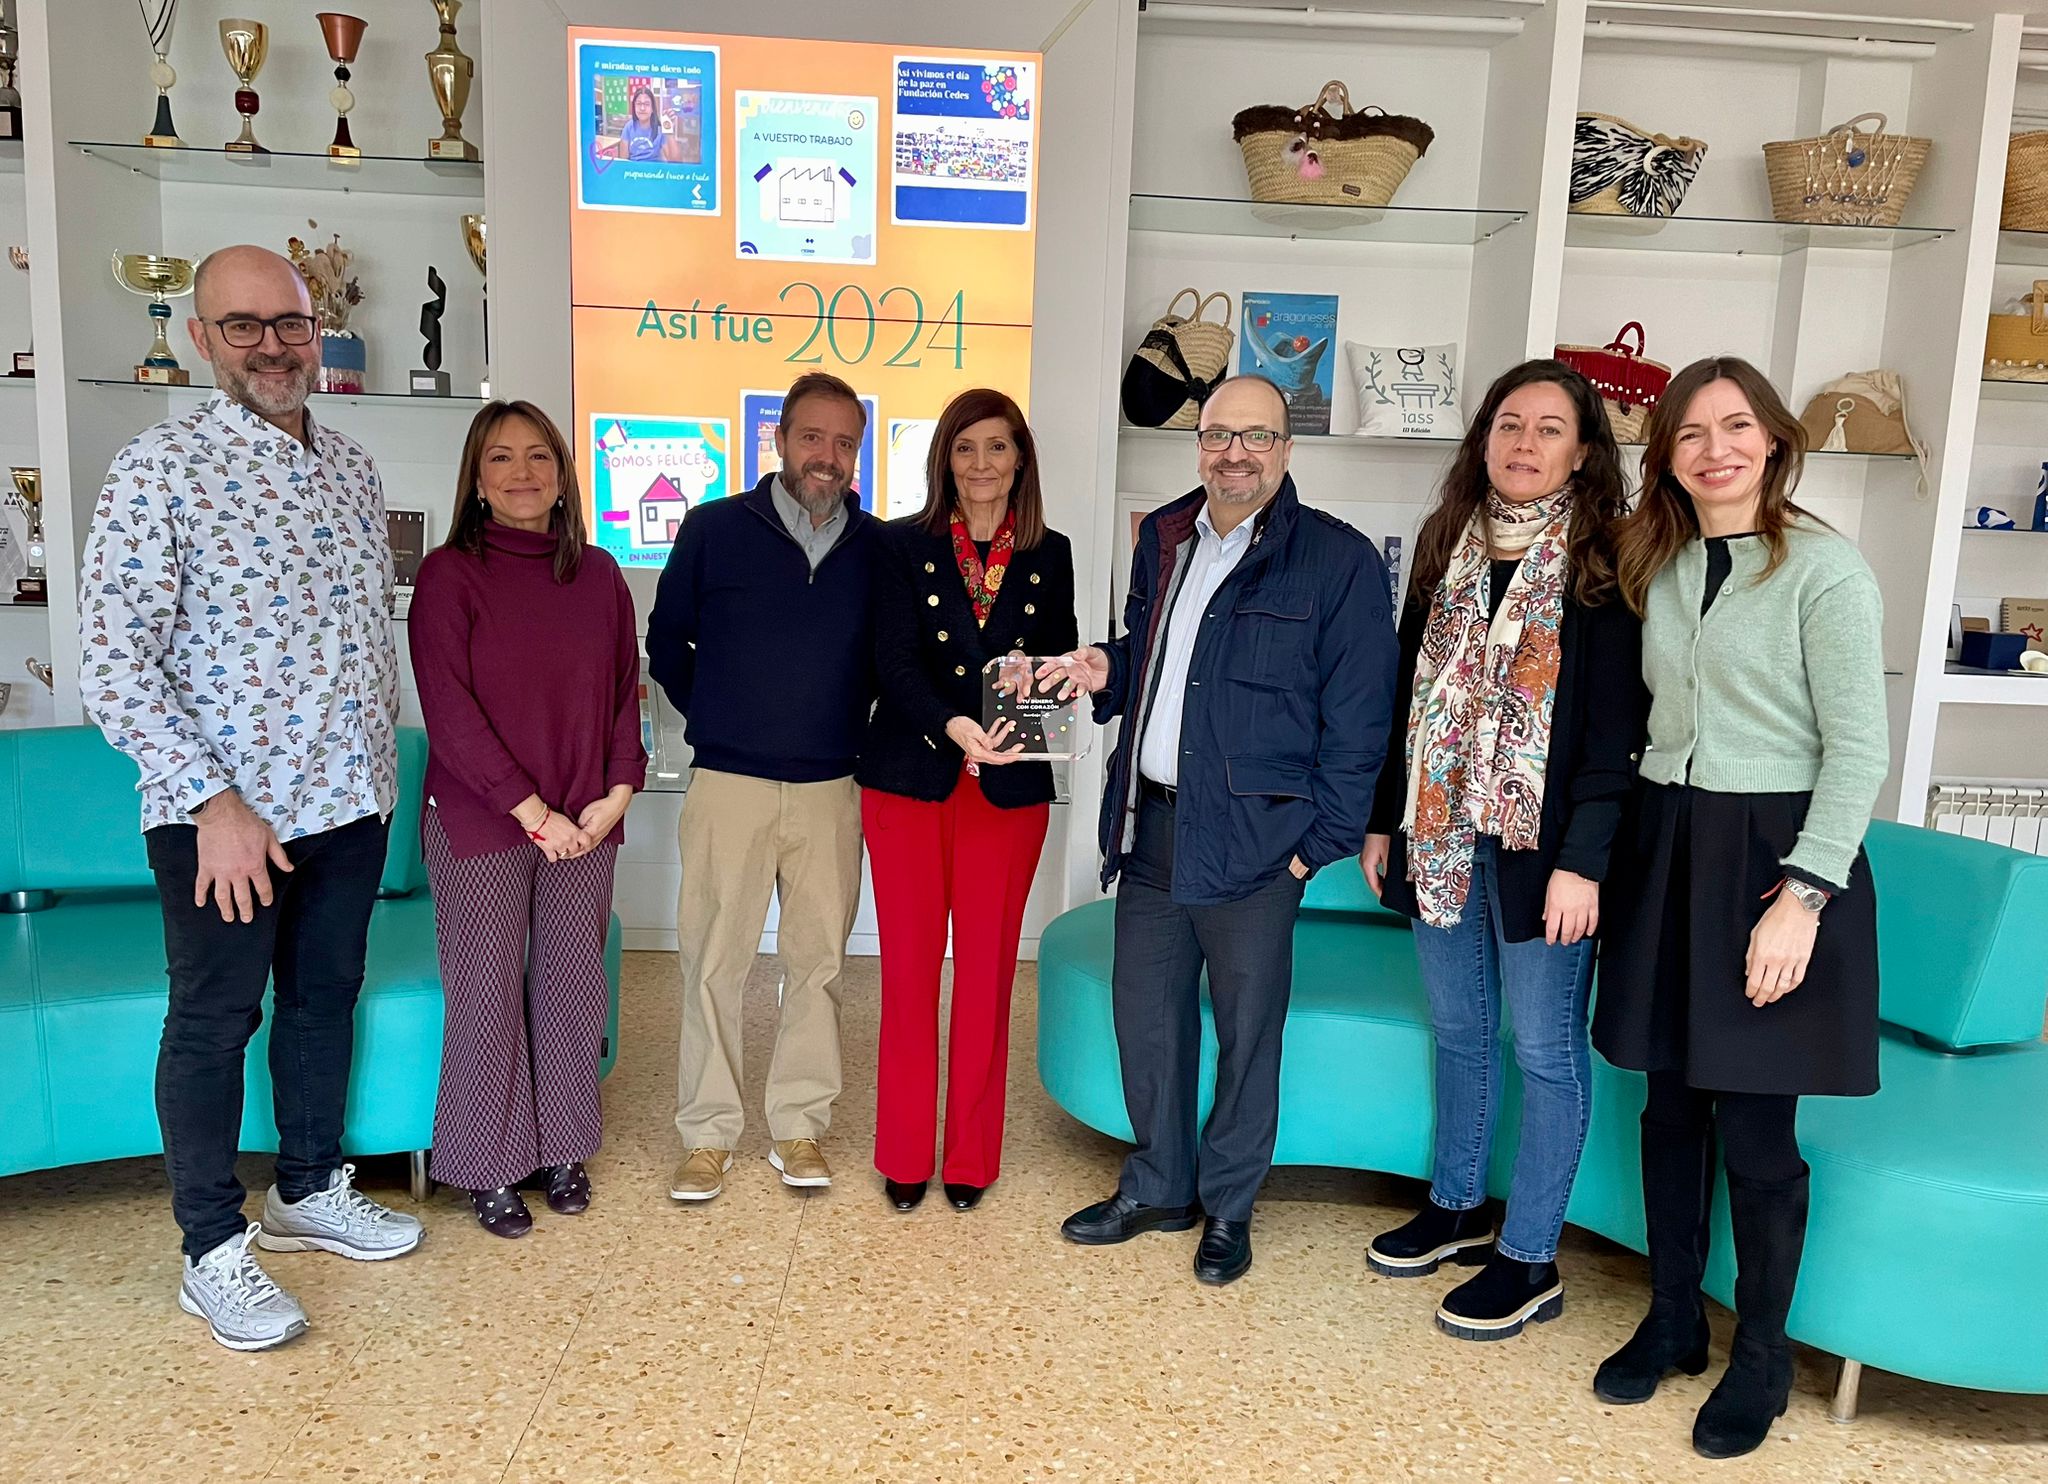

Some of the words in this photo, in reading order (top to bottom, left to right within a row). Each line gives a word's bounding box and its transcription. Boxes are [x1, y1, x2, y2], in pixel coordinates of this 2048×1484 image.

[601, 61, 634, 71] miradas
[635, 64, 650, 73] que
[651, 64, 659, 72] lo
[660, 65, 682, 73] dicen
[683, 66, 702, 74] todo
[912, 69, 945, 79] vivimos
[946, 71, 955, 80] el
[956, 71, 970, 80] día
[898, 79, 908, 87] de
[910, 79, 919, 87] la
[920, 81, 935, 90] paz
[898, 88, 943, 99] Fundación
[944, 89, 970, 100] Cedes
[753, 132, 761, 141] A
[762, 133, 808, 144] VUESTRO
[809, 134, 853, 146] TRABAJO
[623, 169, 665, 180] preparando
[666, 171, 685, 180] truco
[1273, 311, 1336, 325] aragoneses
[636, 298, 701, 340] Así
[710, 303, 774, 344] fue
[778, 281, 968, 371] 2024
[1401, 409, 1434, 424] iass
[602, 454, 653, 469] SOMOS
[657, 452, 709, 467] FELICES
[629, 552, 640, 562] EN
